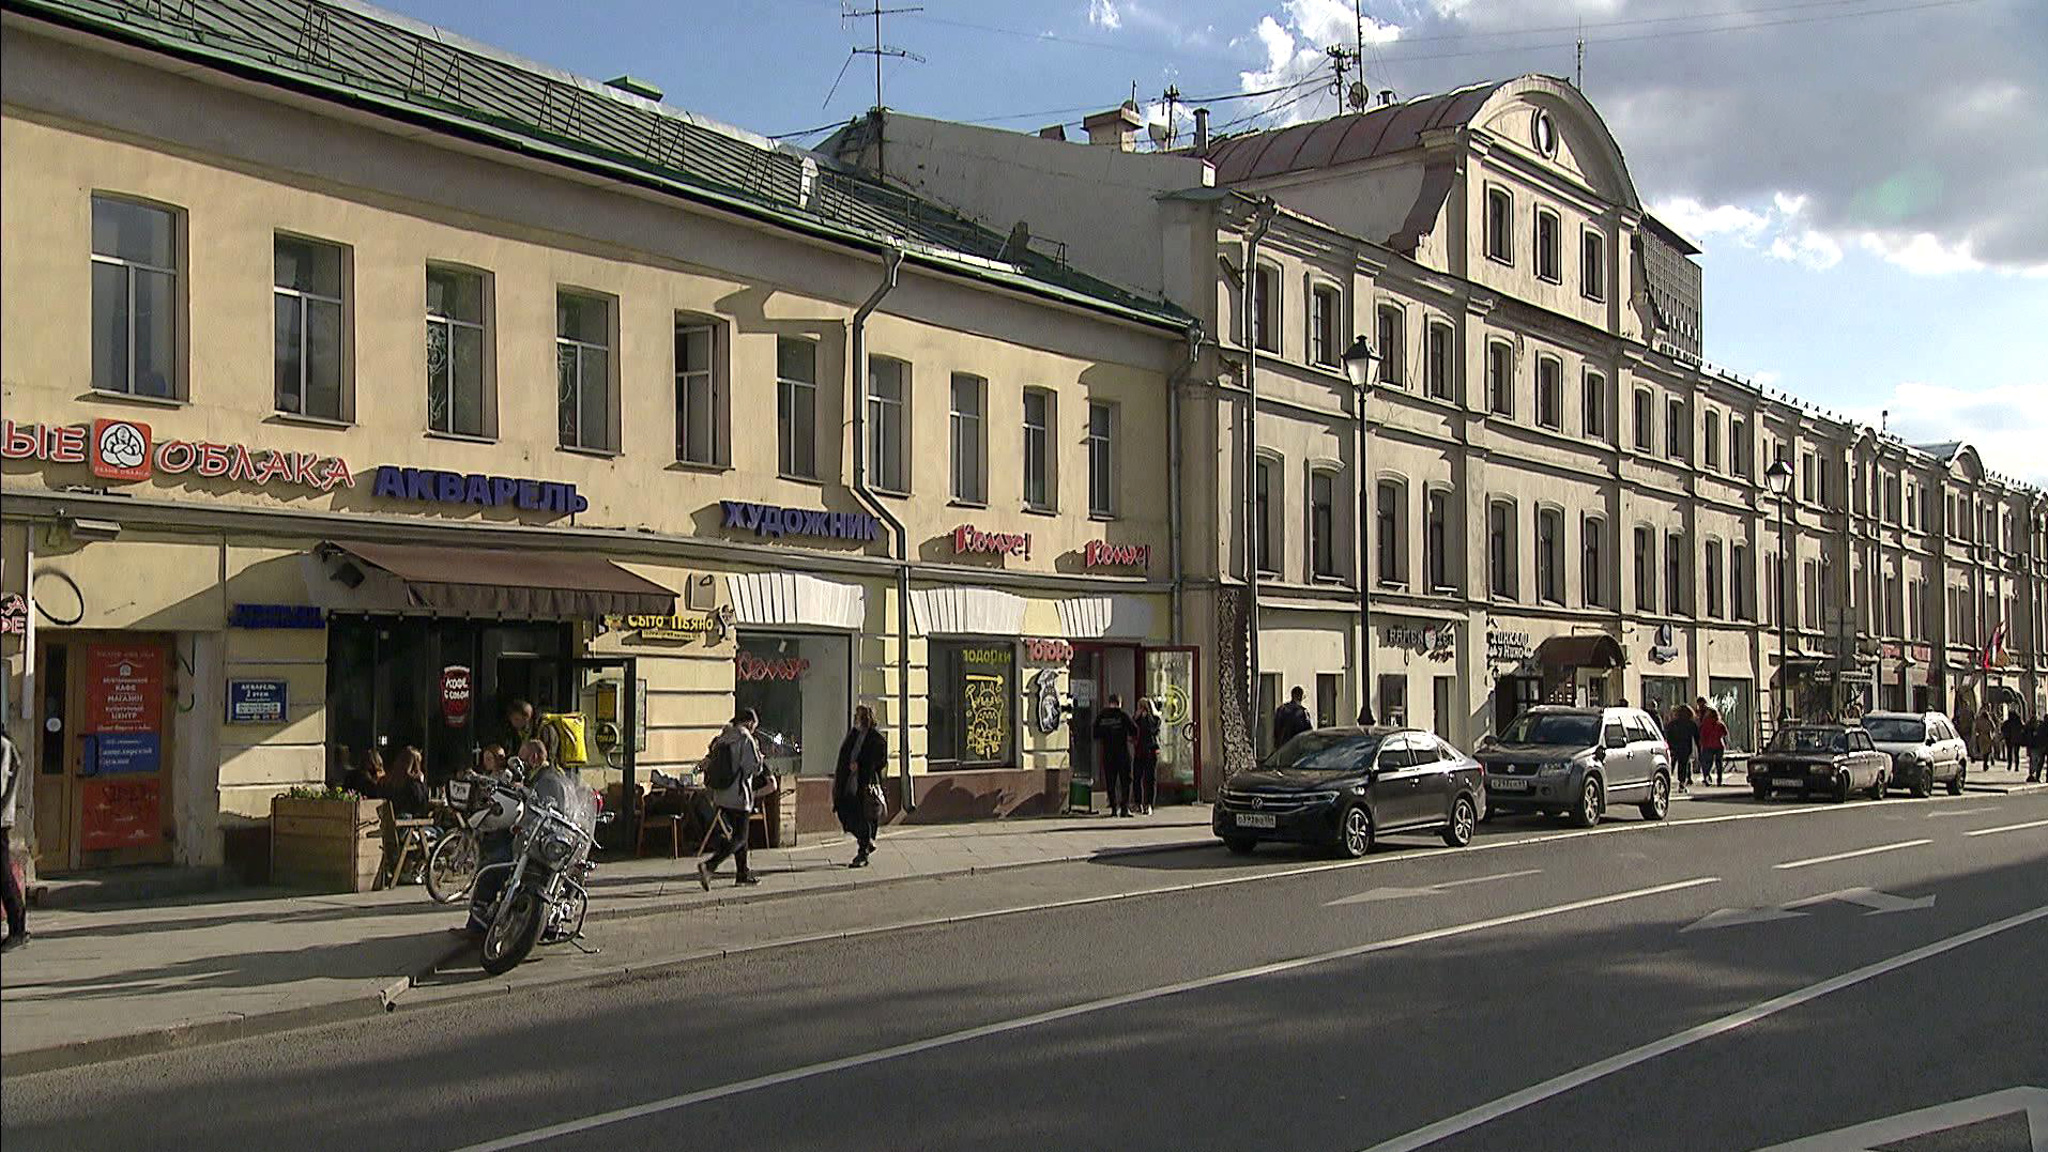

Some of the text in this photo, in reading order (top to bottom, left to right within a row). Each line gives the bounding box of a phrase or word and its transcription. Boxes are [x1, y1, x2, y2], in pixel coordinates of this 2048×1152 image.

[1, 419, 355, 491] ЫЕ ОБЛАКА
[372, 465, 588, 514] АКВАРЕЛЬ
[719, 500, 881, 541] ХУДОЖНИК
